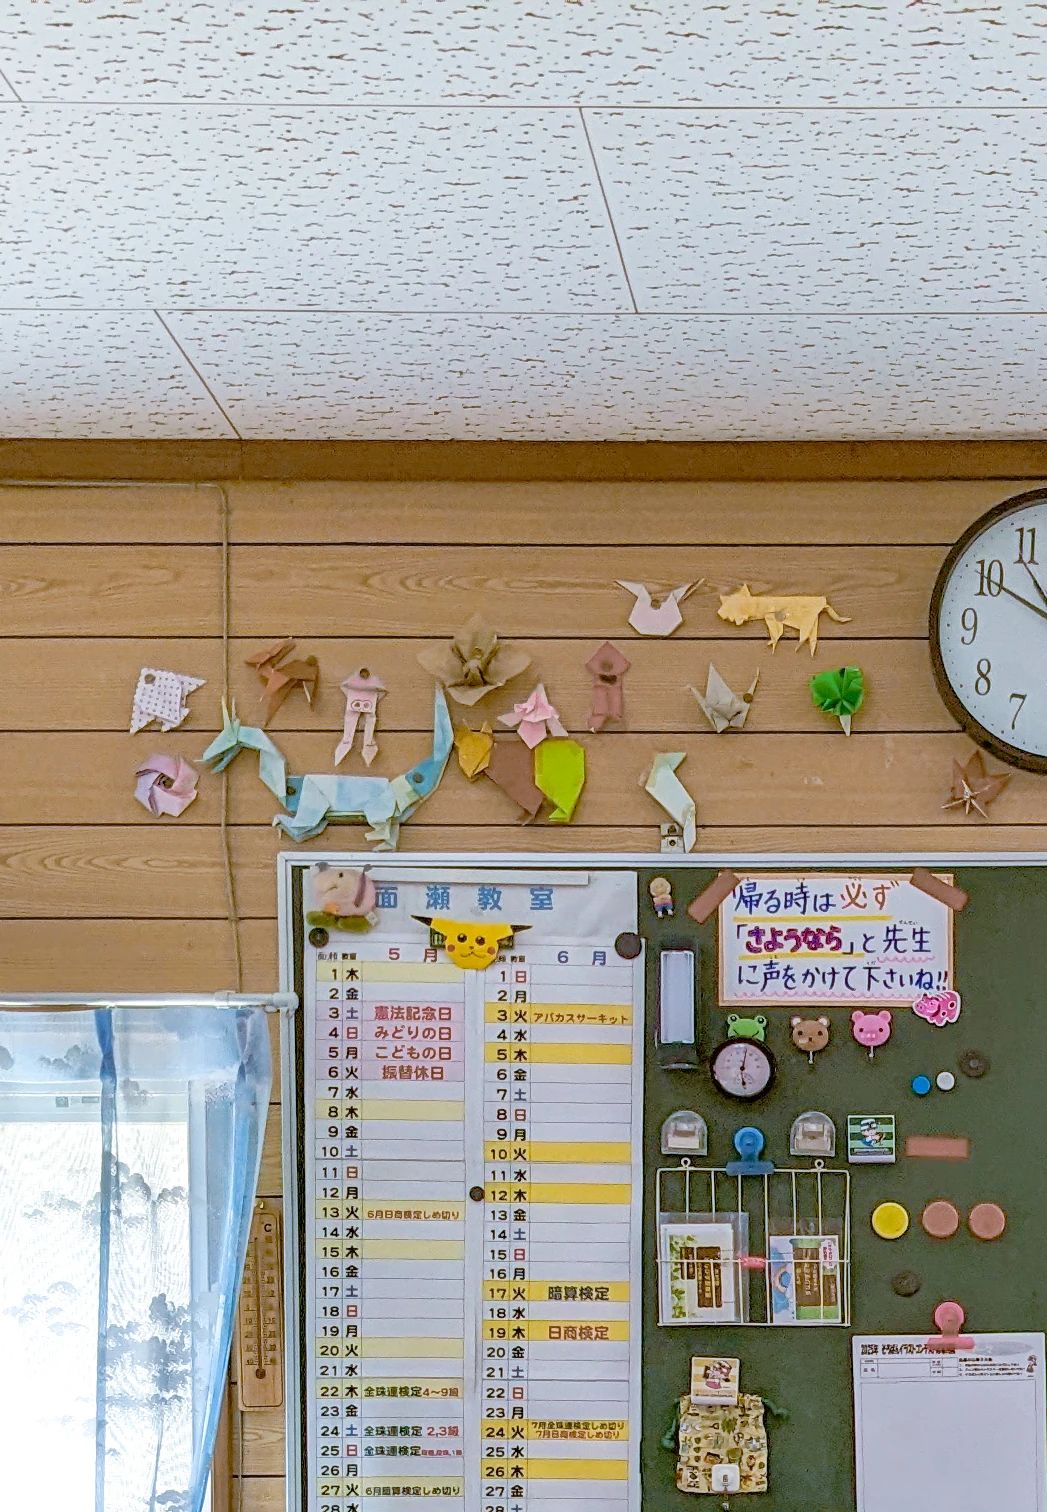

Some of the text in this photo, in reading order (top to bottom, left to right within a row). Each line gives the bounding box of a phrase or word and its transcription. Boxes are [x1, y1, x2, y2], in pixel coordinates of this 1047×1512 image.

[1014, 527, 1039, 564] 11
[974, 559, 1004, 596] 10
[961, 608, 977, 645] 9
[975, 659, 991, 696] 8
[1010, 693, 1027, 730] 7
[375, 886, 554, 911] 面瀬教室
[732, 880, 900, 915] 帰る時は必ず
[736, 923, 932, 955] 「さようなら」と先生
[389, 948, 438, 962] 5月
[557, 950, 606, 966] 6月
[332, 968, 358, 981] 1 木
[501, 971, 526, 983] 1 日
[329, 1006, 452, 1021] 3 土 憲法記念日
[497, 1010, 628, 1025] 3 火 アバカスサーキット
[329, 1026, 452, 1041] 4 日 みどりの日
[329, 1046, 452, 1060] 5 月 こどもの日
[329, 1065, 444, 1080] 6 火 振替休日
[328, 1106, 358, 1120] 8 木
[323, 1145, 358, 1160] 10 土
[490, 1148, 526, 1163] 10 火
[491, 1189, 527, 1202] 12 木
[323, 1207, 339, 1217] 13
[346, 1206, 359, 1220] 火
[323, 1246, 358, 1259] 15 木
[487, 1286, 609, 1301] 17 火 暗算検定
[488, 1326, 609, 1340] 19 木 日商検定
[322, 1386, 338, 1397] 22
[345, 1385, 358, 1398] 木
[321, 1426, 338, 1436] 24
[346, 1424, 358, 1438] 土
[486, 1426, 524, 1439] 24 火
[321, 1446, 340, 1458] 25
[347, 1445, 357, 1456] 日
[321, 1485, 340, 1495] 27
[346, 1484, 359, 1496] 火
